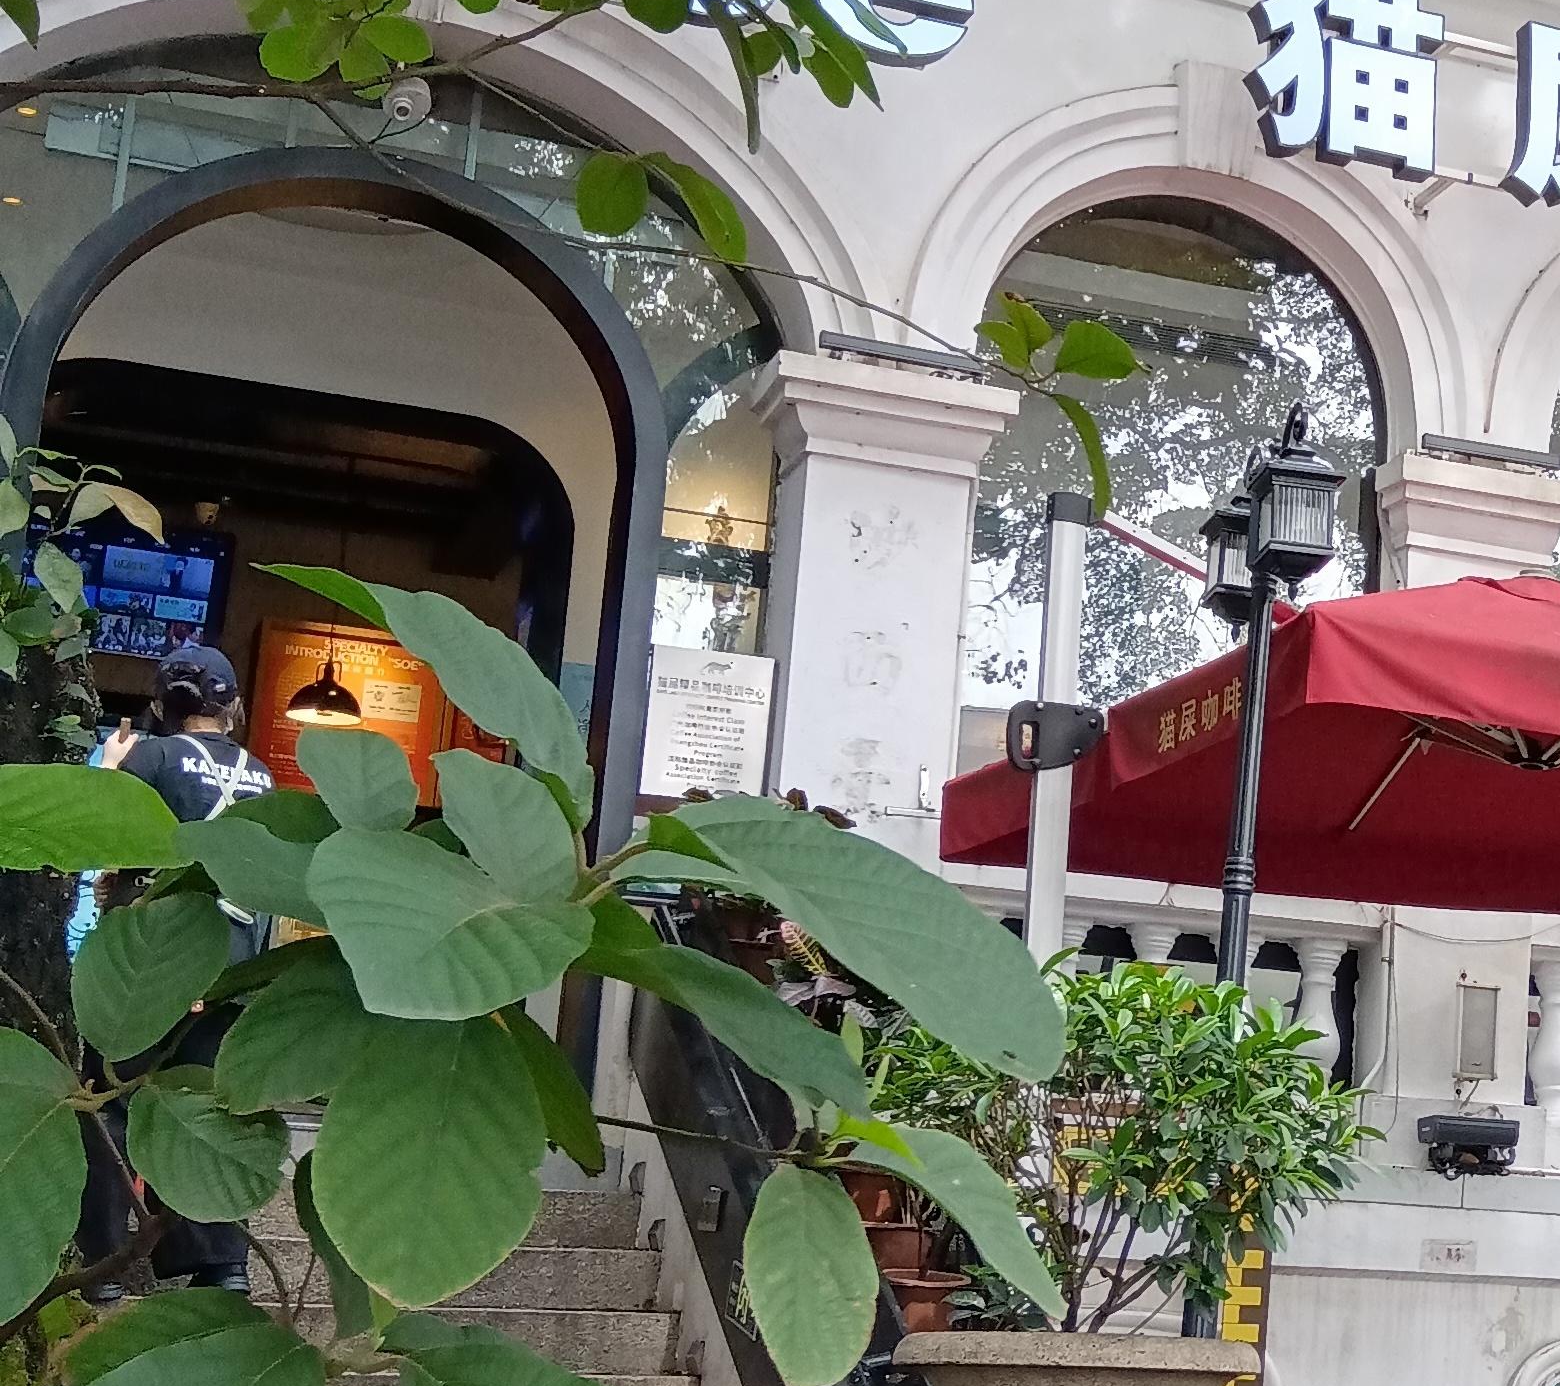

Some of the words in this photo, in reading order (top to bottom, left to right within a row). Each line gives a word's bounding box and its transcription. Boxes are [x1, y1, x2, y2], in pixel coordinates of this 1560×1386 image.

[323, 638, 389, 657] SPECIALTY
[1157, 676, 1243, 754] 猫屎咖啡
